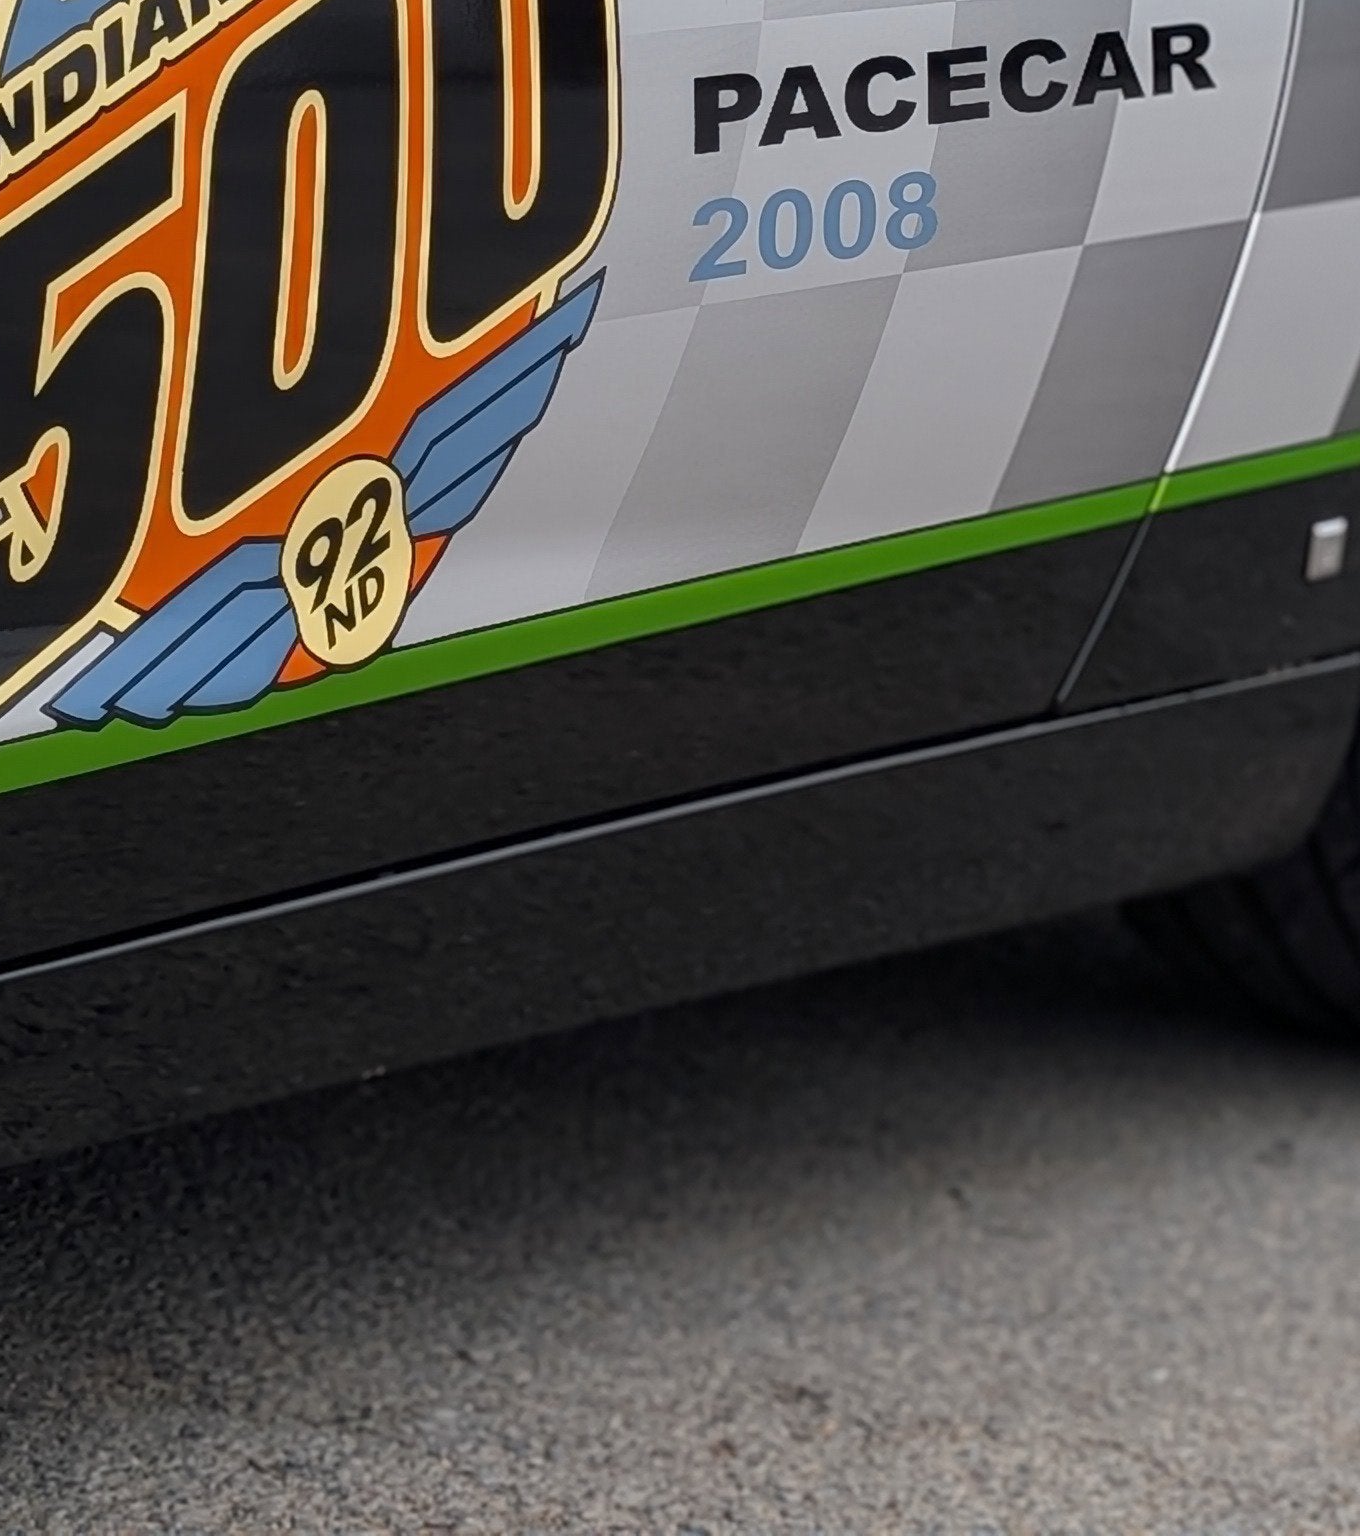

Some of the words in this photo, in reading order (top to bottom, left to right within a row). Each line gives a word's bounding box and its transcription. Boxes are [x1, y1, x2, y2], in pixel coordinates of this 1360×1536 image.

[693, 23, 1217, 155] PACECAR
[688, 170, 938, 282] 2008
[297, 477, 392, 613] 92
[325, 566, 386, 650] ND
